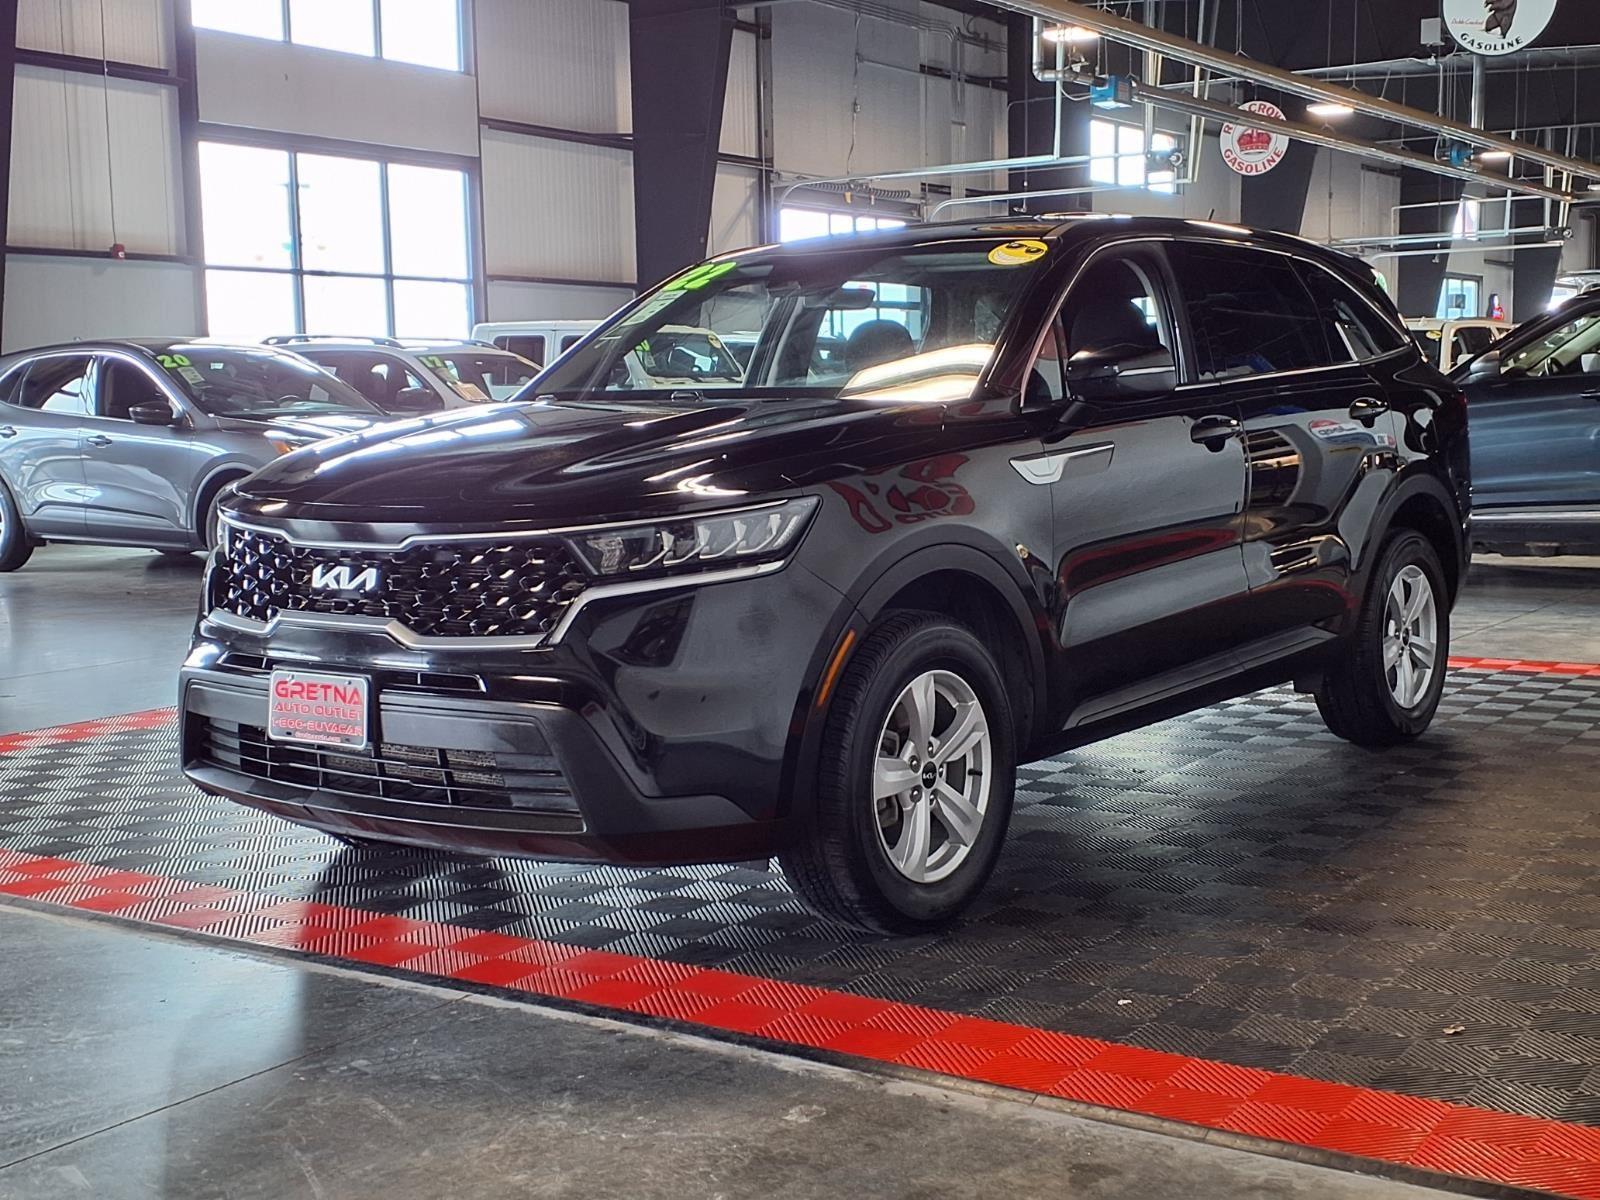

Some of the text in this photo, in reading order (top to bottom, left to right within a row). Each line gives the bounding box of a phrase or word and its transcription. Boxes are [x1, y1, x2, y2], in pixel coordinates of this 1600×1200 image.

[1460, 33, 1523, 51] GASOLINE
[1223, 147, 1283, 173] GASOLINE
[156, 353, 191, 368] 20
[312, 564, 377, 591] KIA
[275, 680, 362, 705] GRETNA
[273, 702, 363, 721] AUTO OUTLET
